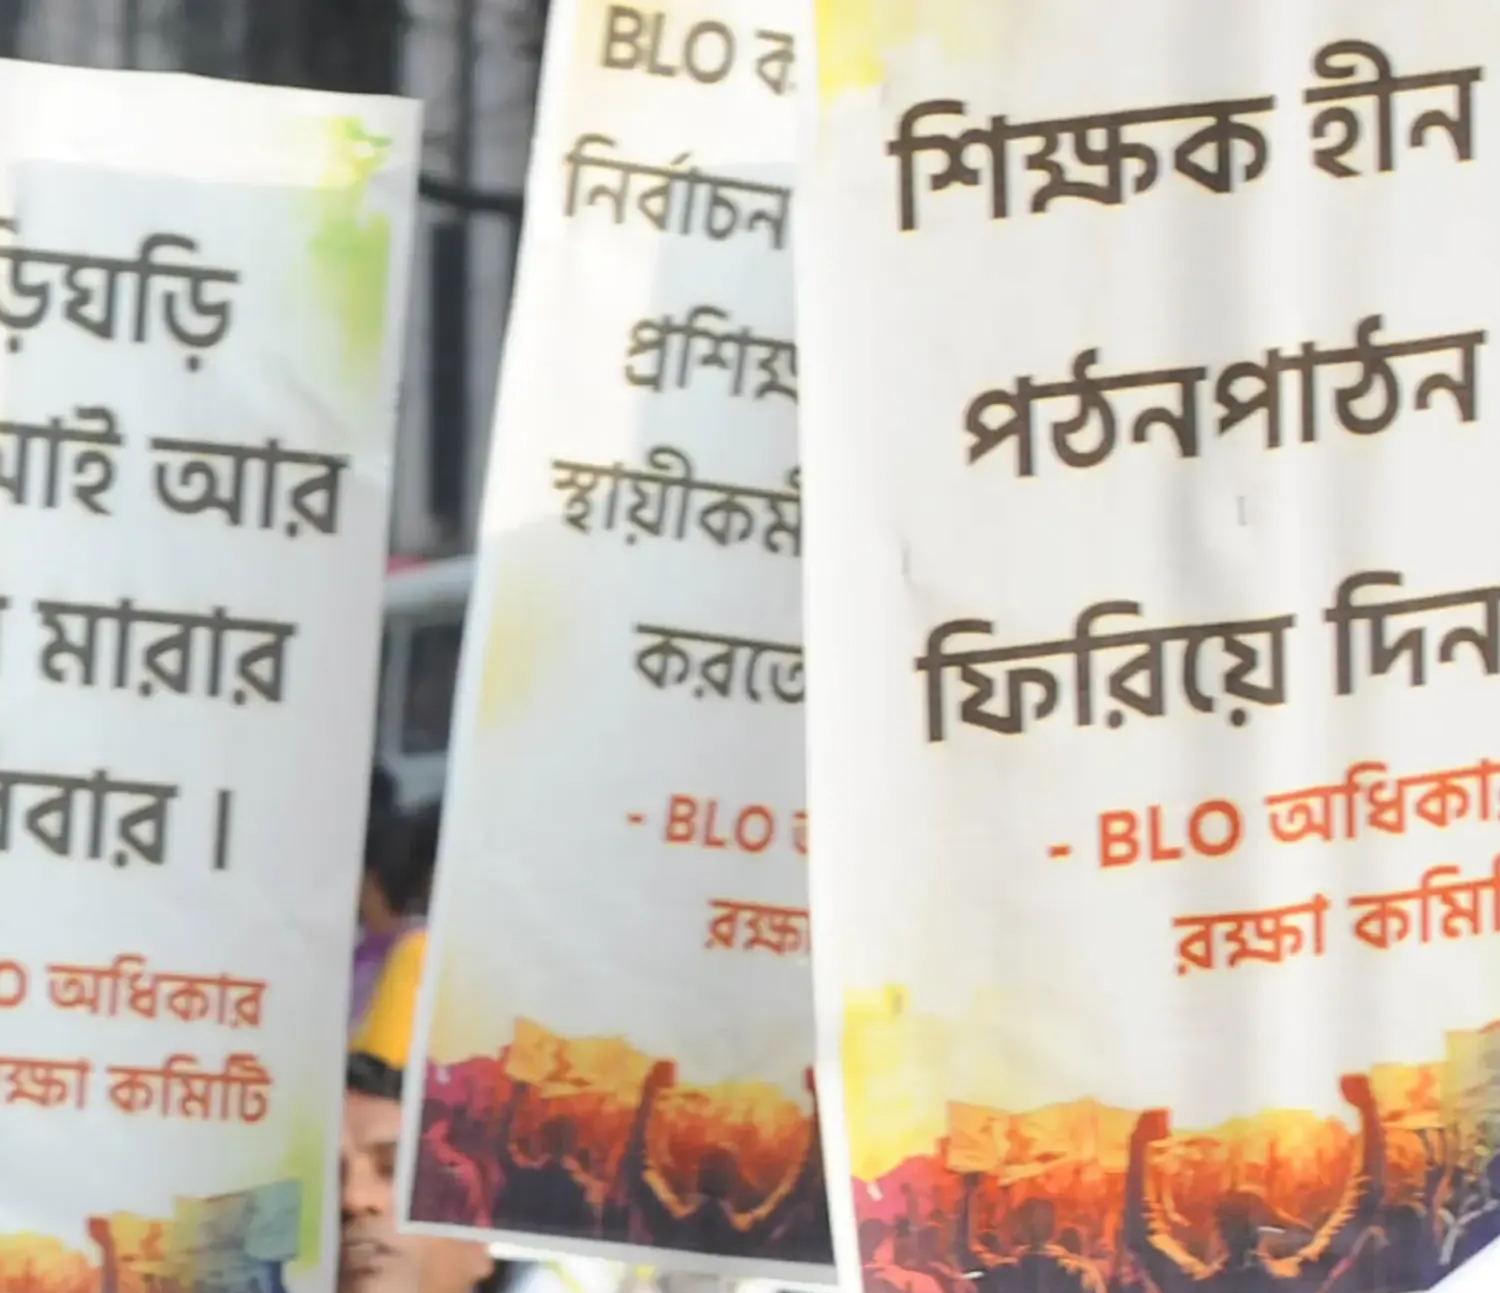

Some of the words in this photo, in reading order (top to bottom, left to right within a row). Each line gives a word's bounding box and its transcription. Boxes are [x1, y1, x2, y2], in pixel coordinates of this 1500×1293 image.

[602, 5, 734, 84] BLO
[887, 96, 1275, 231] শিক্ষক
[1304, 40, 1482, 178] হীন
[565, 134, 791, 250] নির্বাচন
[150, 438, 349, 537] আর
[36, 598, 296, 705] মারার
[915, 601, 1294, 742] ফিরিয়ে
[665, 795, 774, 853] BLO
[1100, 800, 1241, 867] BLO
[1173, 894, 1328, 975] রক্ষা
[47, 955, 267, 1027] অধিকার
[106, 1054, 272, 1123] কমিটি
